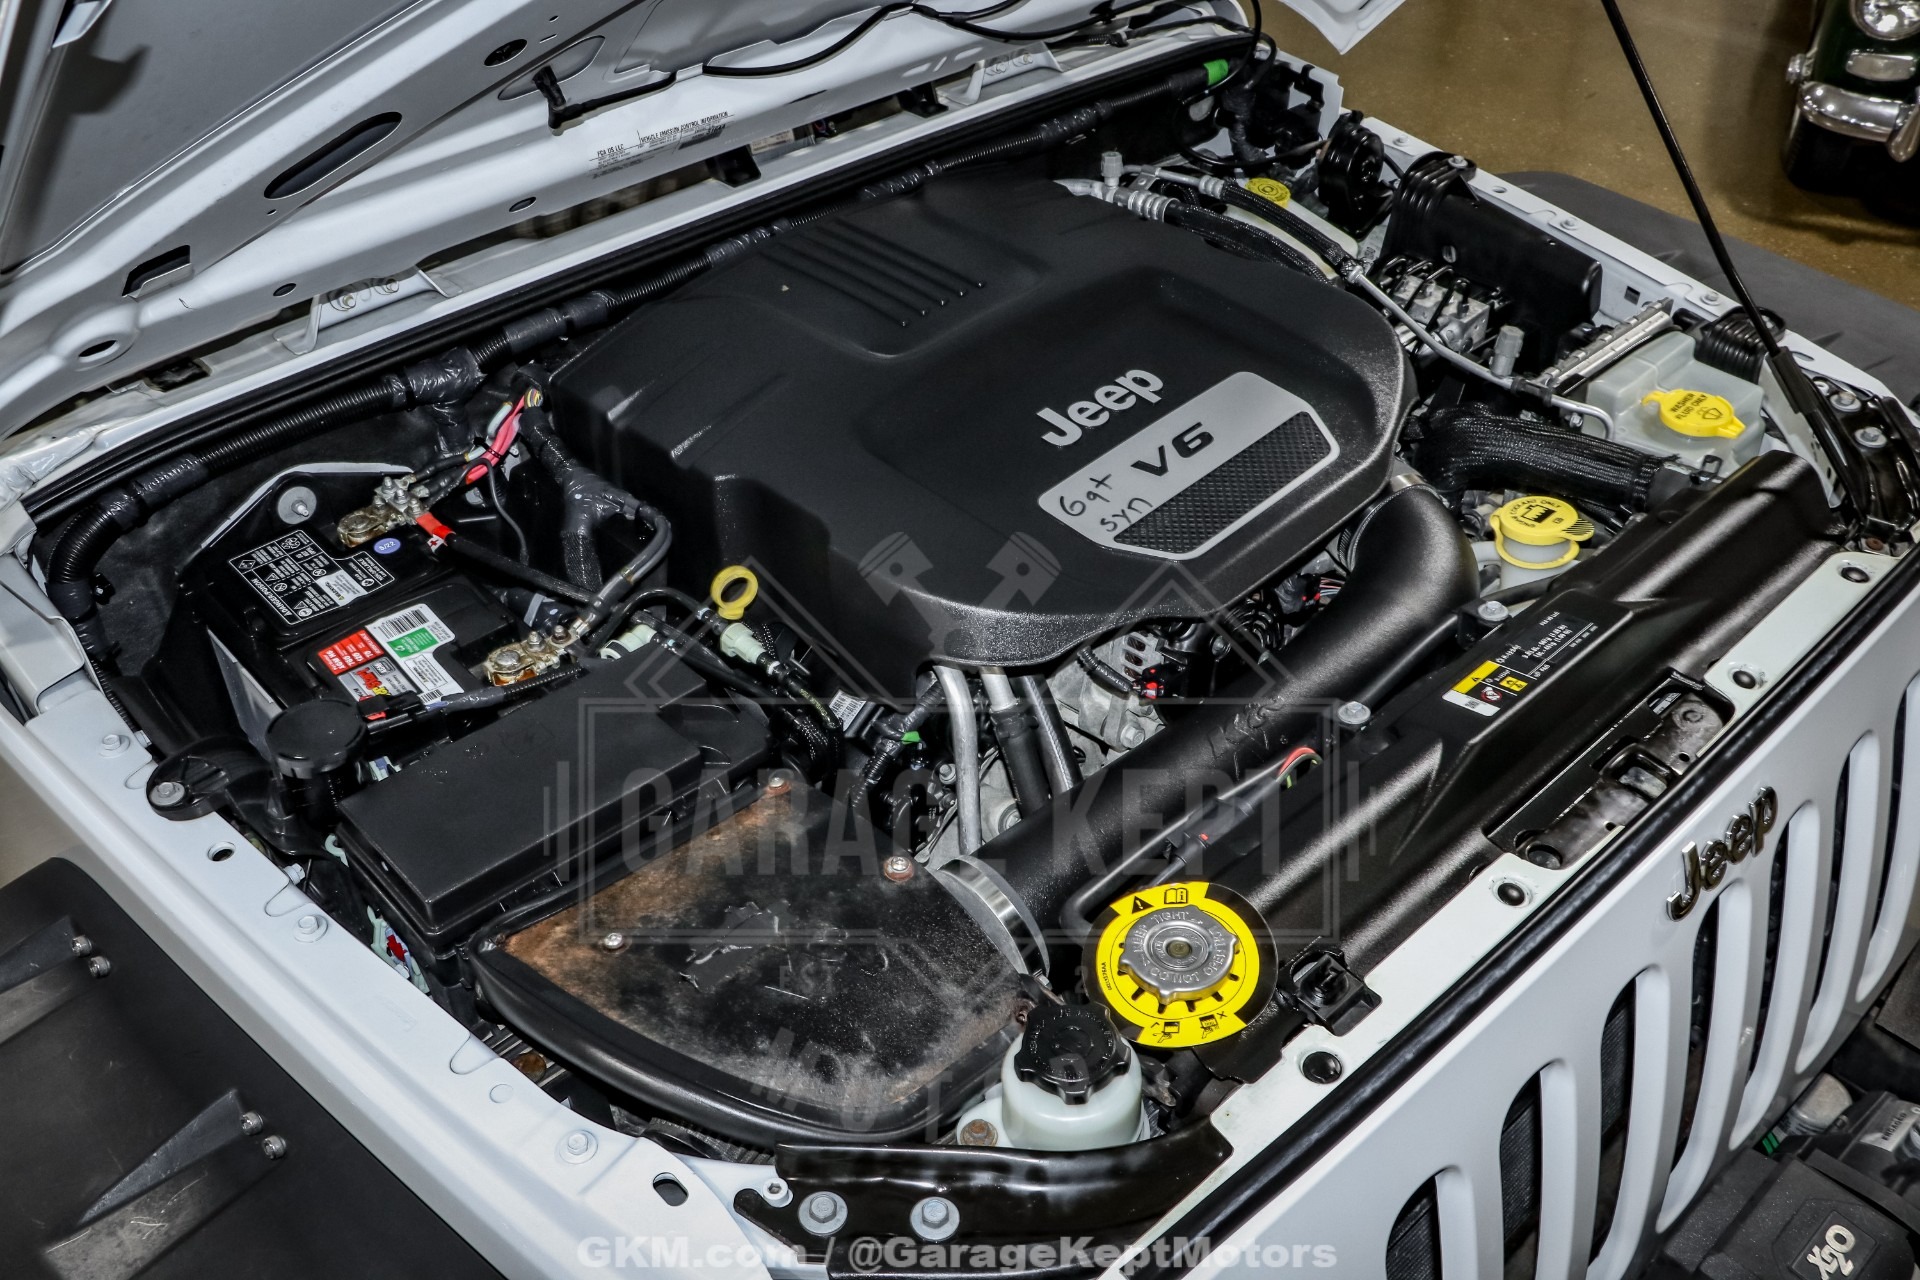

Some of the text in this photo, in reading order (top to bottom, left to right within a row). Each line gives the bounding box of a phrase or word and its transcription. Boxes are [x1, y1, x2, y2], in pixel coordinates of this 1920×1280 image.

[1036, 369, 1164, 447] Jeep
[1130, 421, 1215, 477] V6
[1666, 786, 1778, 922] Jeep
[1150, 911, 1190, 925] TIGHT
